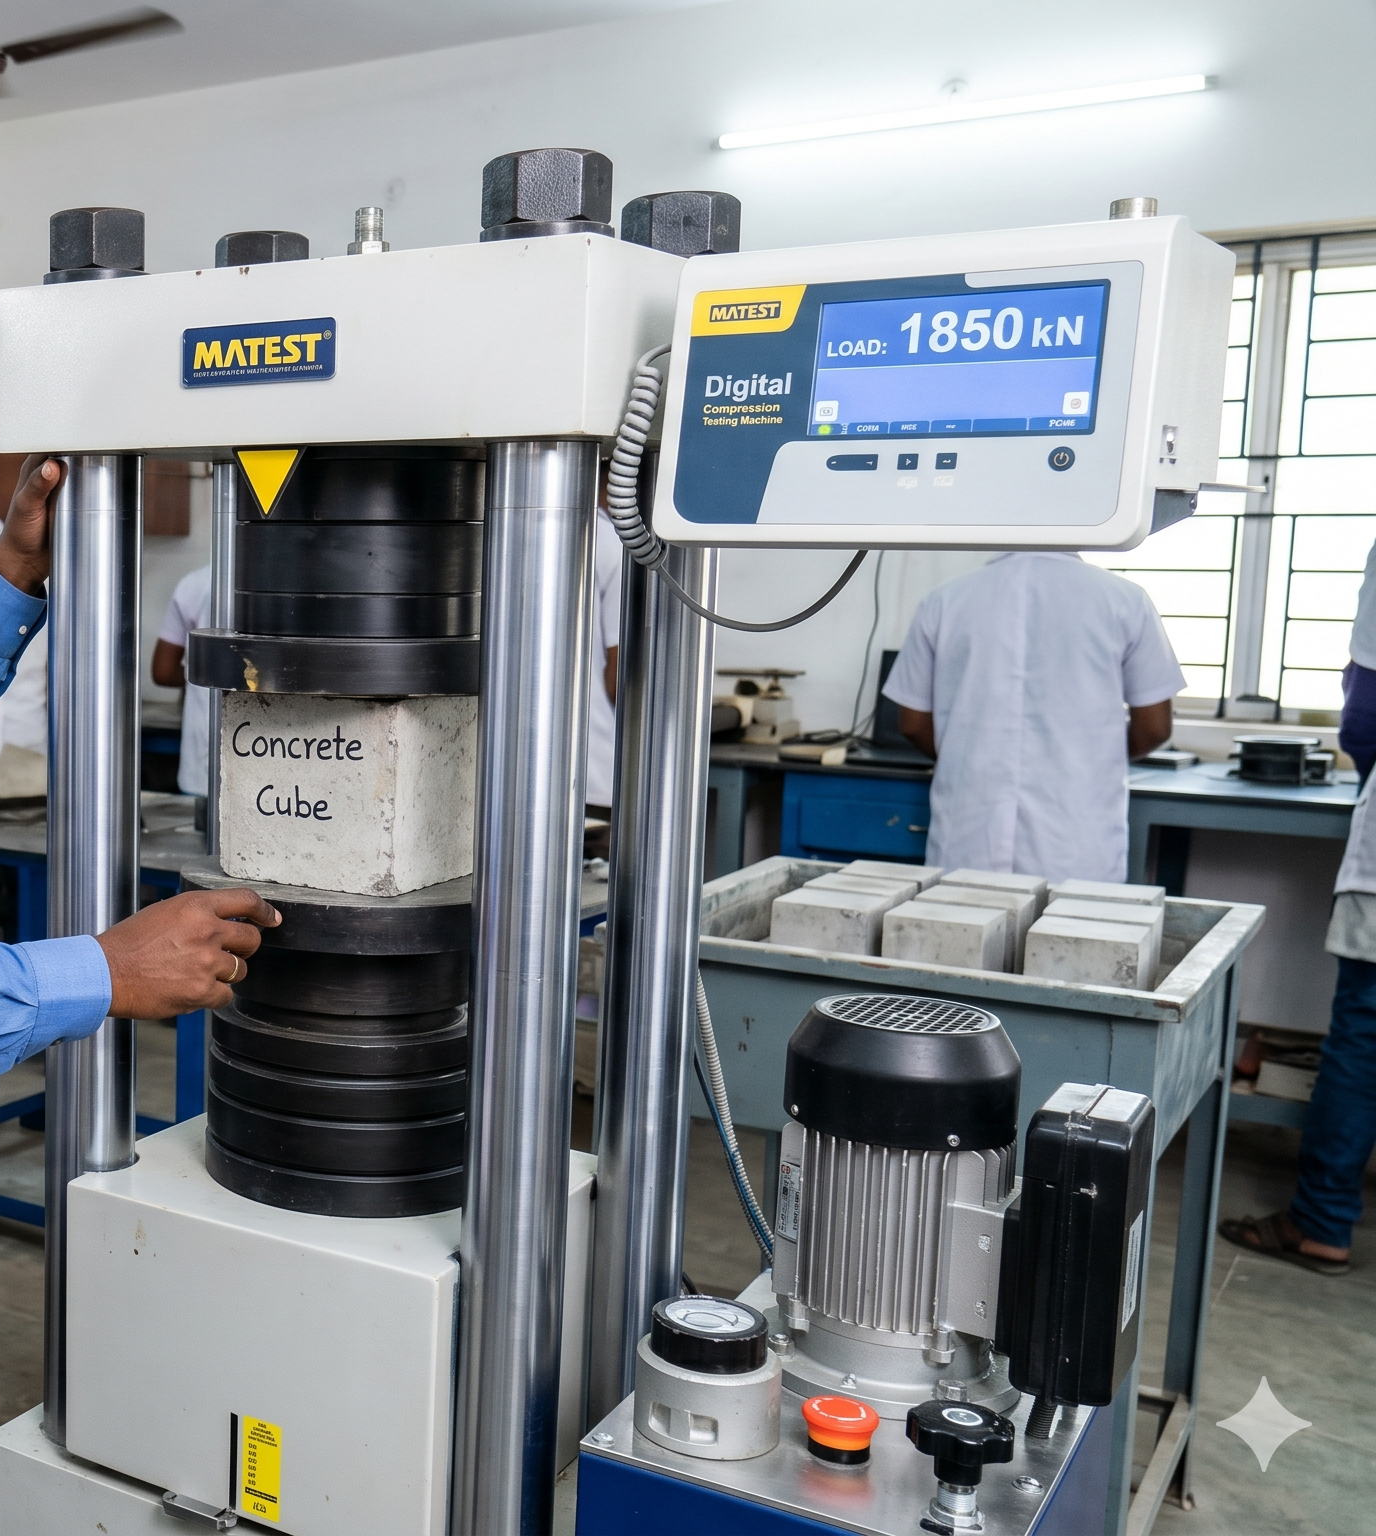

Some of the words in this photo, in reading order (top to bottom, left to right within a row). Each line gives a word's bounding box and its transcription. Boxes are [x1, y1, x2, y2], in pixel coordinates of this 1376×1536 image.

[711, 303, 780, 321] MATEST
[827, 339, 887, 357] LOAD:
[900, 307, 1024, 354] 1850
[1031, 315, 1084, 347] kN
[705, 372, 792, 402] Digital
[703, 403, 780, 415] Compression
[703, 416, 738, 427] Testing
[740, 415, 783, 426] Machine
[232, 721, 364, 760] Concrete
[256, 784, 333, 821] Cube
